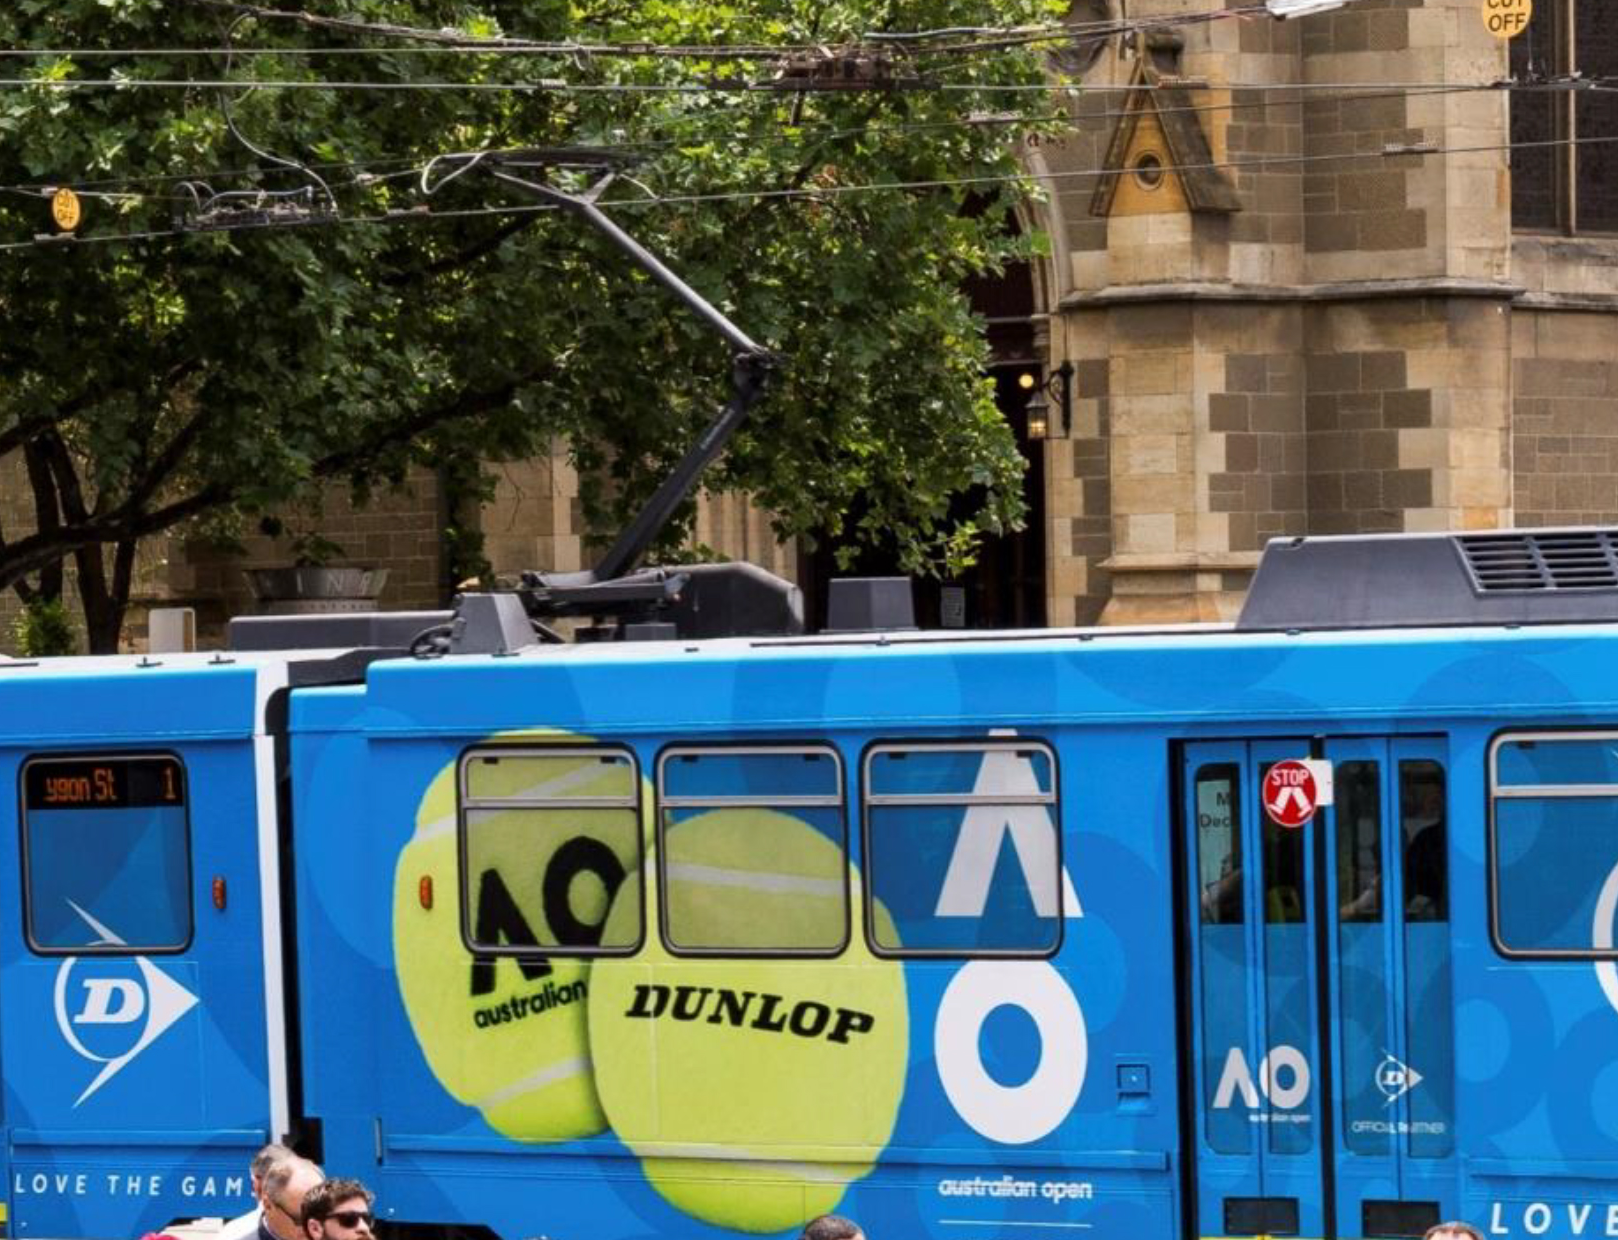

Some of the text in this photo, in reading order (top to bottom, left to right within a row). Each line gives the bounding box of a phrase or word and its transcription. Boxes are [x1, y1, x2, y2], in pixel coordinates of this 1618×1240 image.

[1488, 13, 1526, 32] OFF
[163, 767, 177, 800] 1
[1270, 768, 1309, 787] STOP
[474, 979, 588, 1029] australian
[625, 984, 875, 1044] DUNLOP
[14, 1173, 255, 1197] LOVE THE GAM
[938, 1174, 1093, 1204] australian open
